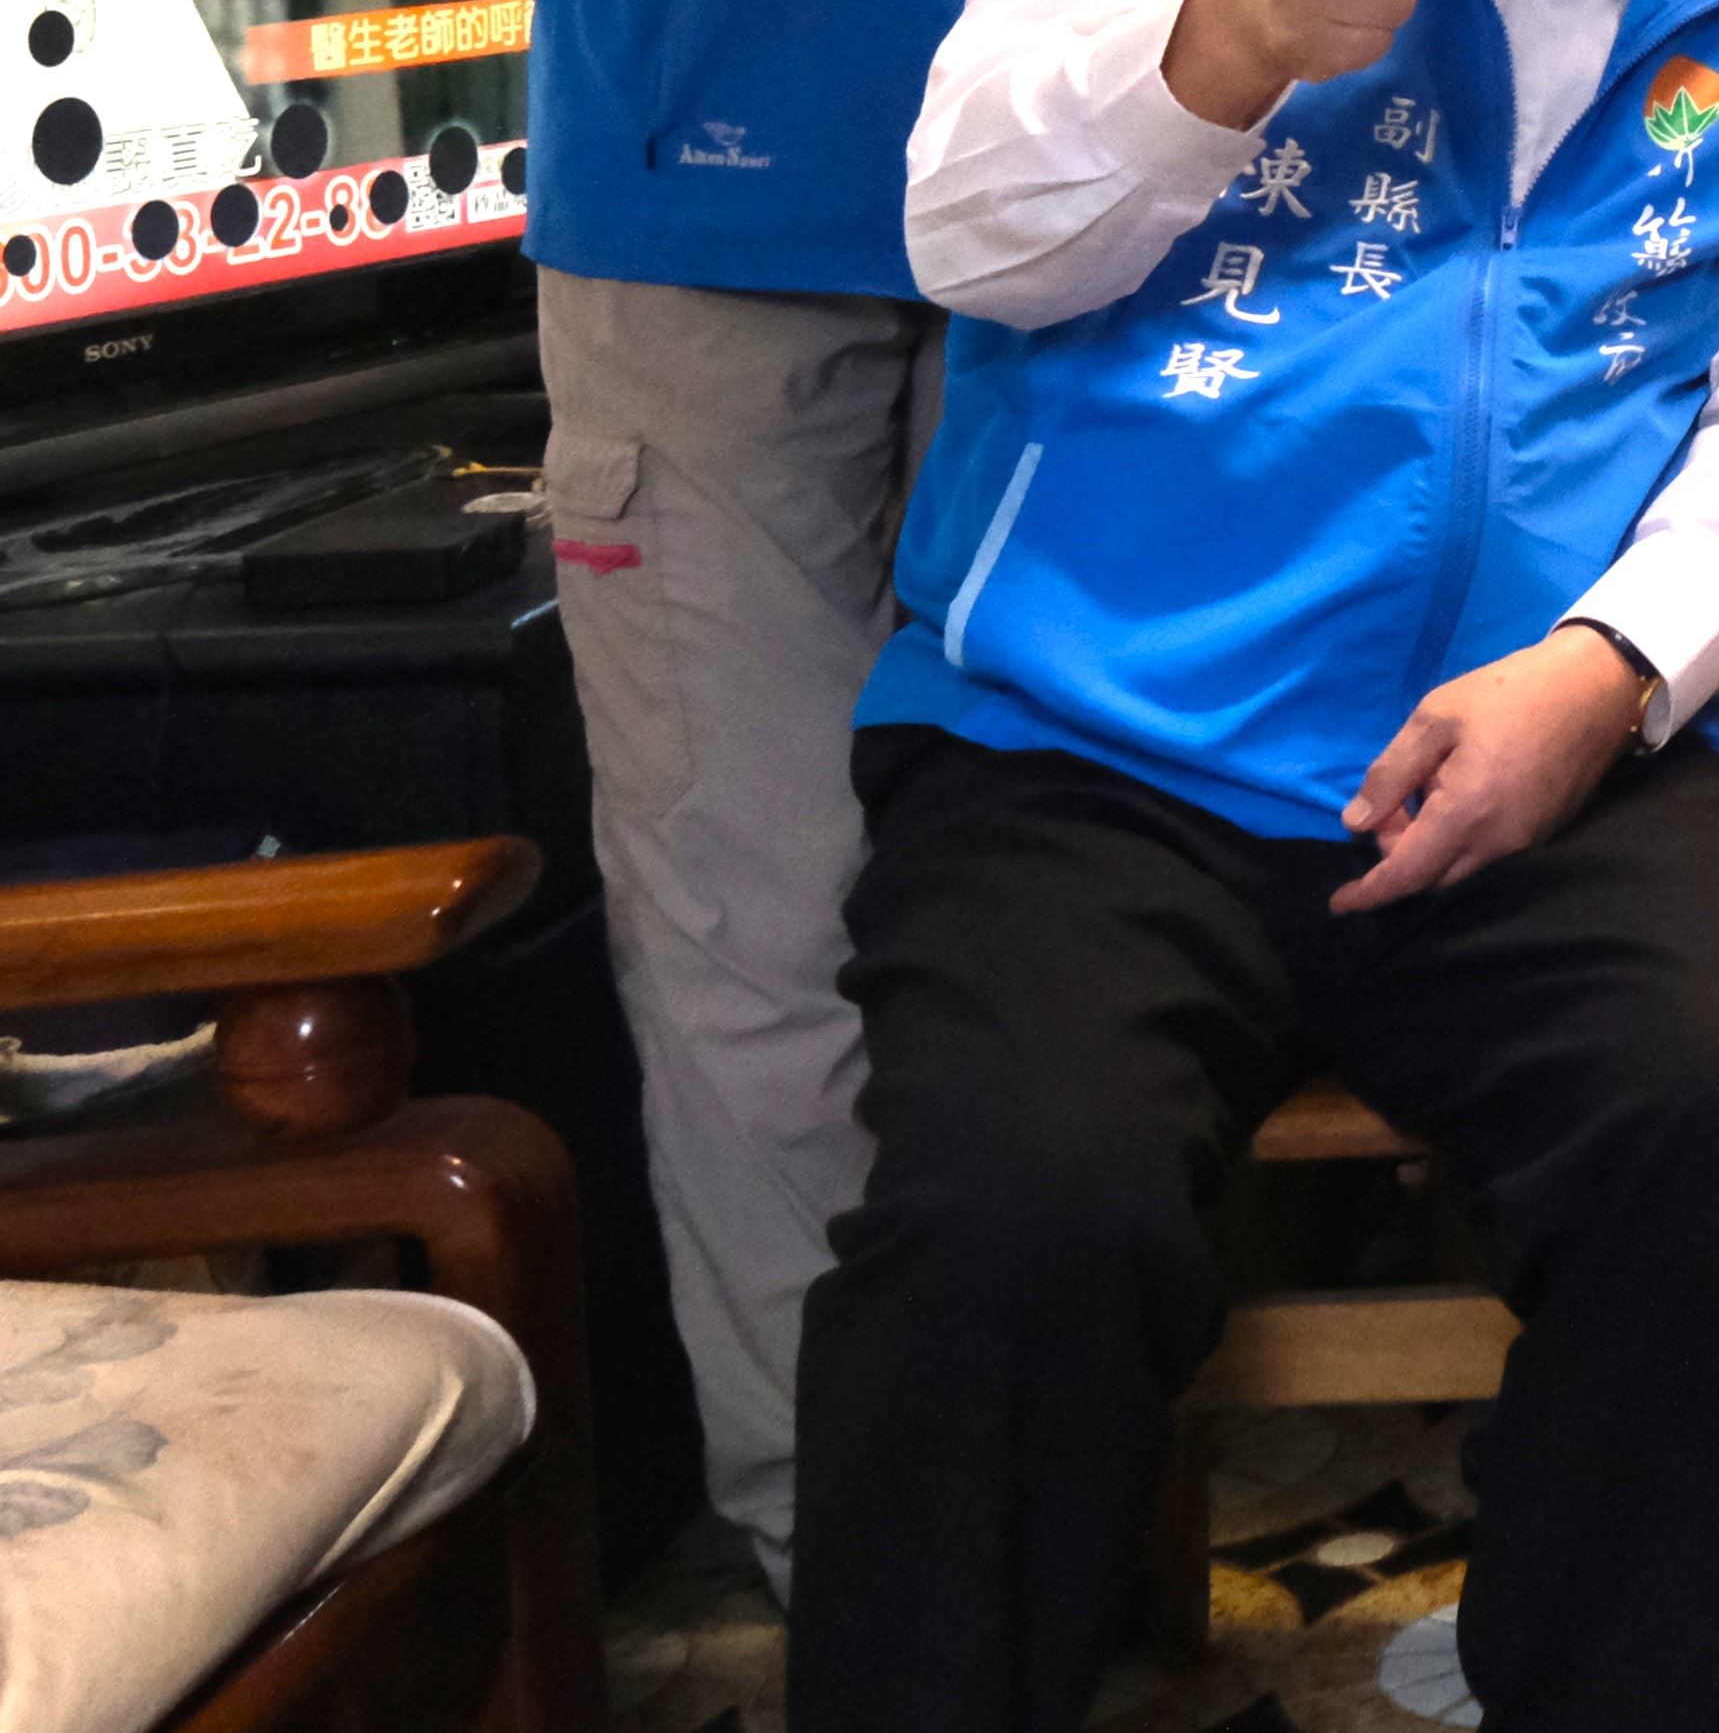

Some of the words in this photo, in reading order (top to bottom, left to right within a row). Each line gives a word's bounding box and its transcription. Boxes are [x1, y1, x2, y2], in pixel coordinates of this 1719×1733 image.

[311, 0, 535, 72] 醫生老師的呼
[1330, 96, 1440, 300] 副縣長
[85, 335, 154, 363] SONY
